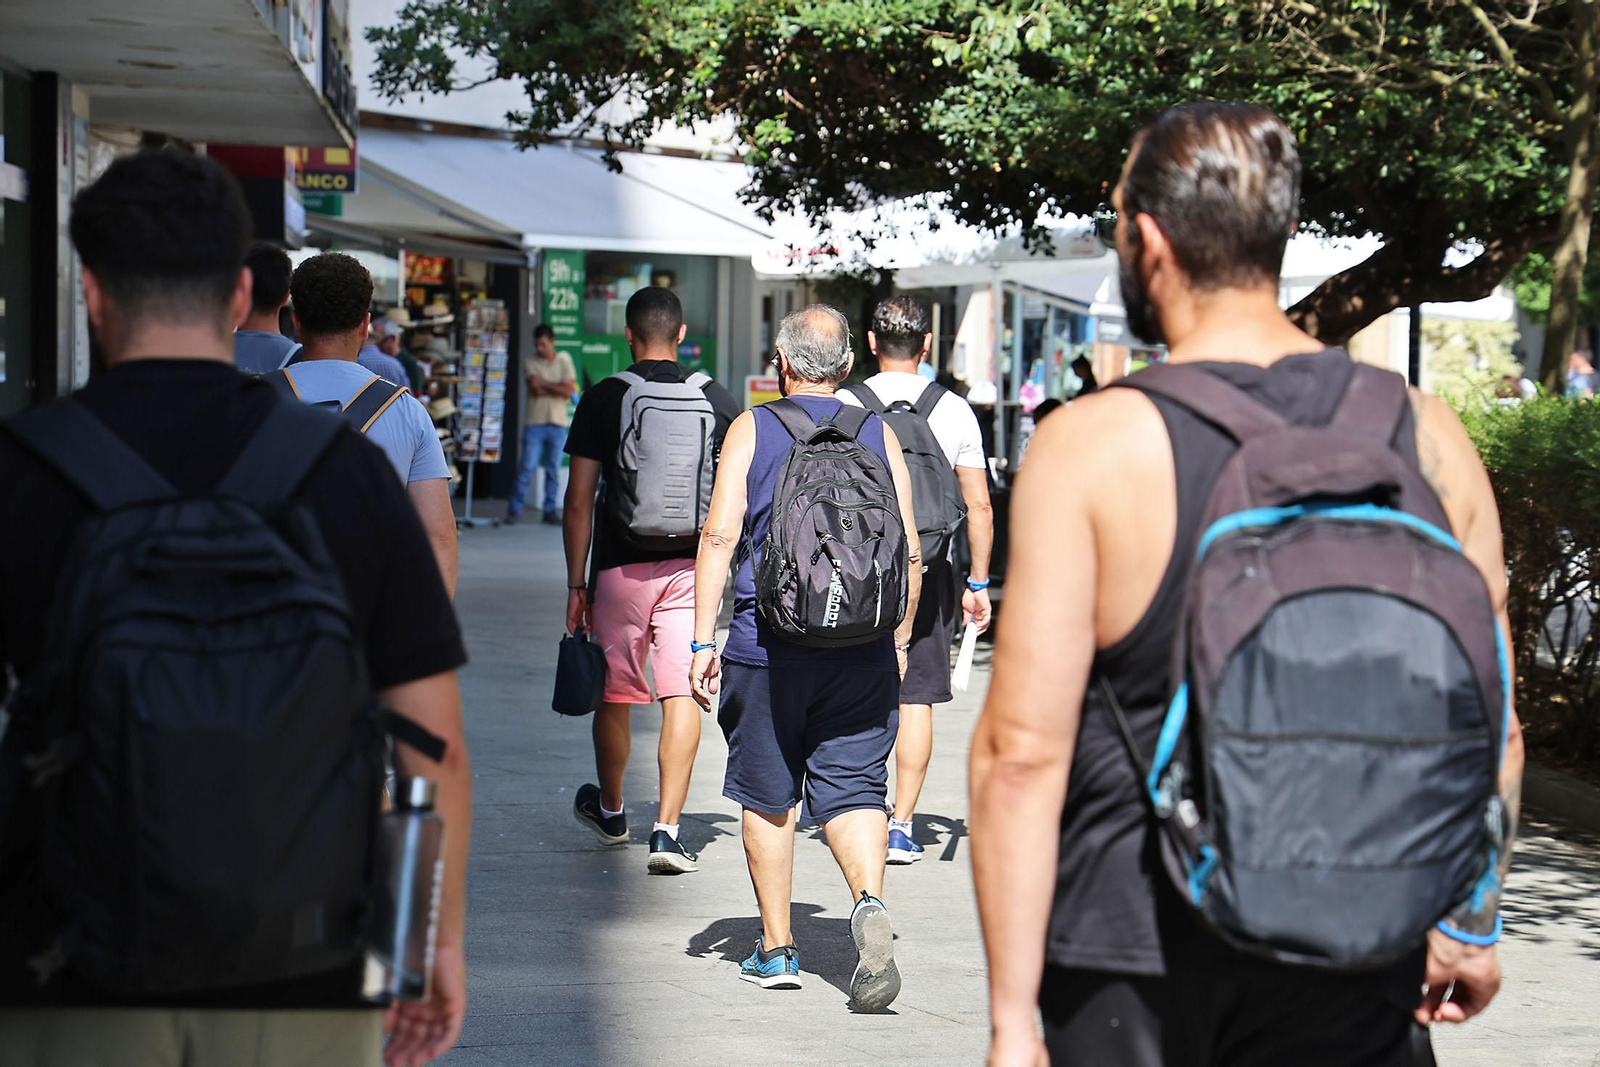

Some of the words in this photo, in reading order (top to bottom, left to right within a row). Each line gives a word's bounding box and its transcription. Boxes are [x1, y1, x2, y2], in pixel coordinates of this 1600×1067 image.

[296, 174, 348, 190] ANCO
[550, 259, 571, 283] 9h
[549, 287, 579, 310] 22h
[661, 429, 696, 519] PUMA
